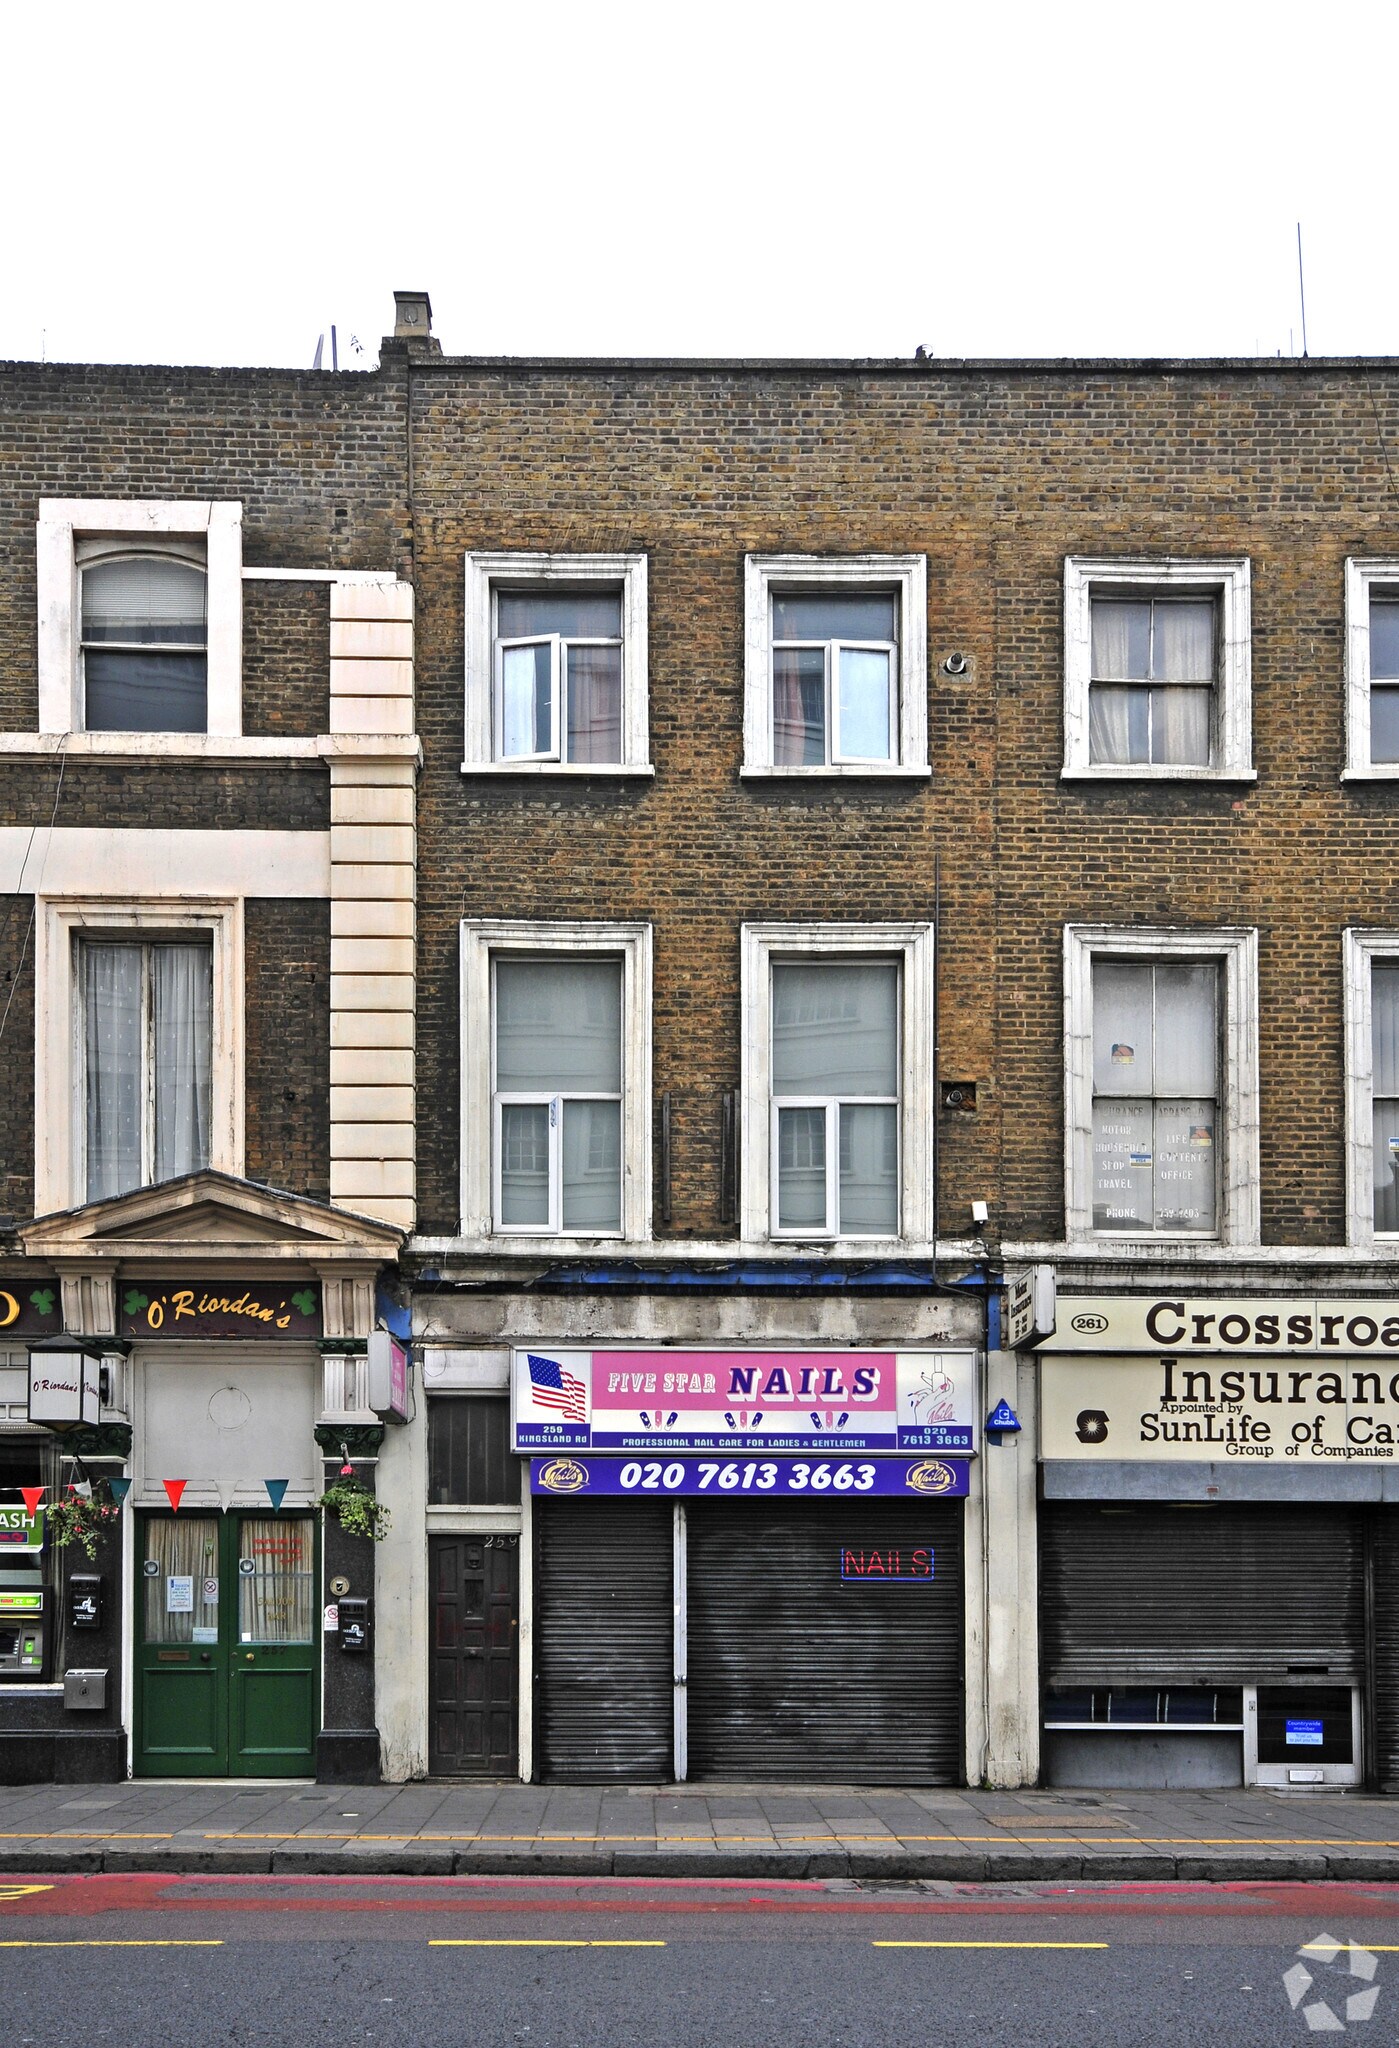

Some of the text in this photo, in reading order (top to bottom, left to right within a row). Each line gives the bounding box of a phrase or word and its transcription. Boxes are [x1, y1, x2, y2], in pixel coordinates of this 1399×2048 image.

[1102, 1125, 1131, 1135] MOTOR
[1166, 1134, 1187, 1144] LIFE
[1161, 1170, 1193, 1180] OFFICE
[1097, 1179, 1132, 1189] TRAVEL
[1106, 1208, 1136, 1218] PHONE
[147, 1290, 291, 1329] O'Riordan's
[1076, 1318, 1103, 1329] 261
[33, 1379, 78, 1393] O'Riordan's
[608, 1366, 881, 1402] FIVE STAR NAILS
[928, 1398, 956, 1424] Nails
[1159, 1402, 1243, 1415] Appointed by
[543, 1425, 563, 1434] 259
[924, 1427, 947, 1435] 020
[1140, 1412, 1271, 1443] SunLife
[1291, 1414, 1326, 1443] of
[519, 1435, 587, 1443] KINGSLAND Rd
[622, 1439, 690, 1447] PROFESSIONAL
[694, 1439, 715, 1447] NAIL
[719, 1439, 743, 1447] CARE
[746, 1439, 764, 1447] FOR
[768, 1439, 800, 1447] LADIES
[812, 1439, 866, 1448] GENTLEMEN
[902, 1435, 969, 1445] 7613 3663
[1225, 1443, 1394, 1459] Group of Companies
[619, 1462, 876, 1490] 020 7613 3663
[484, 1535, 518, 1549] 259
[261, 1645, 288, 1655] 257
